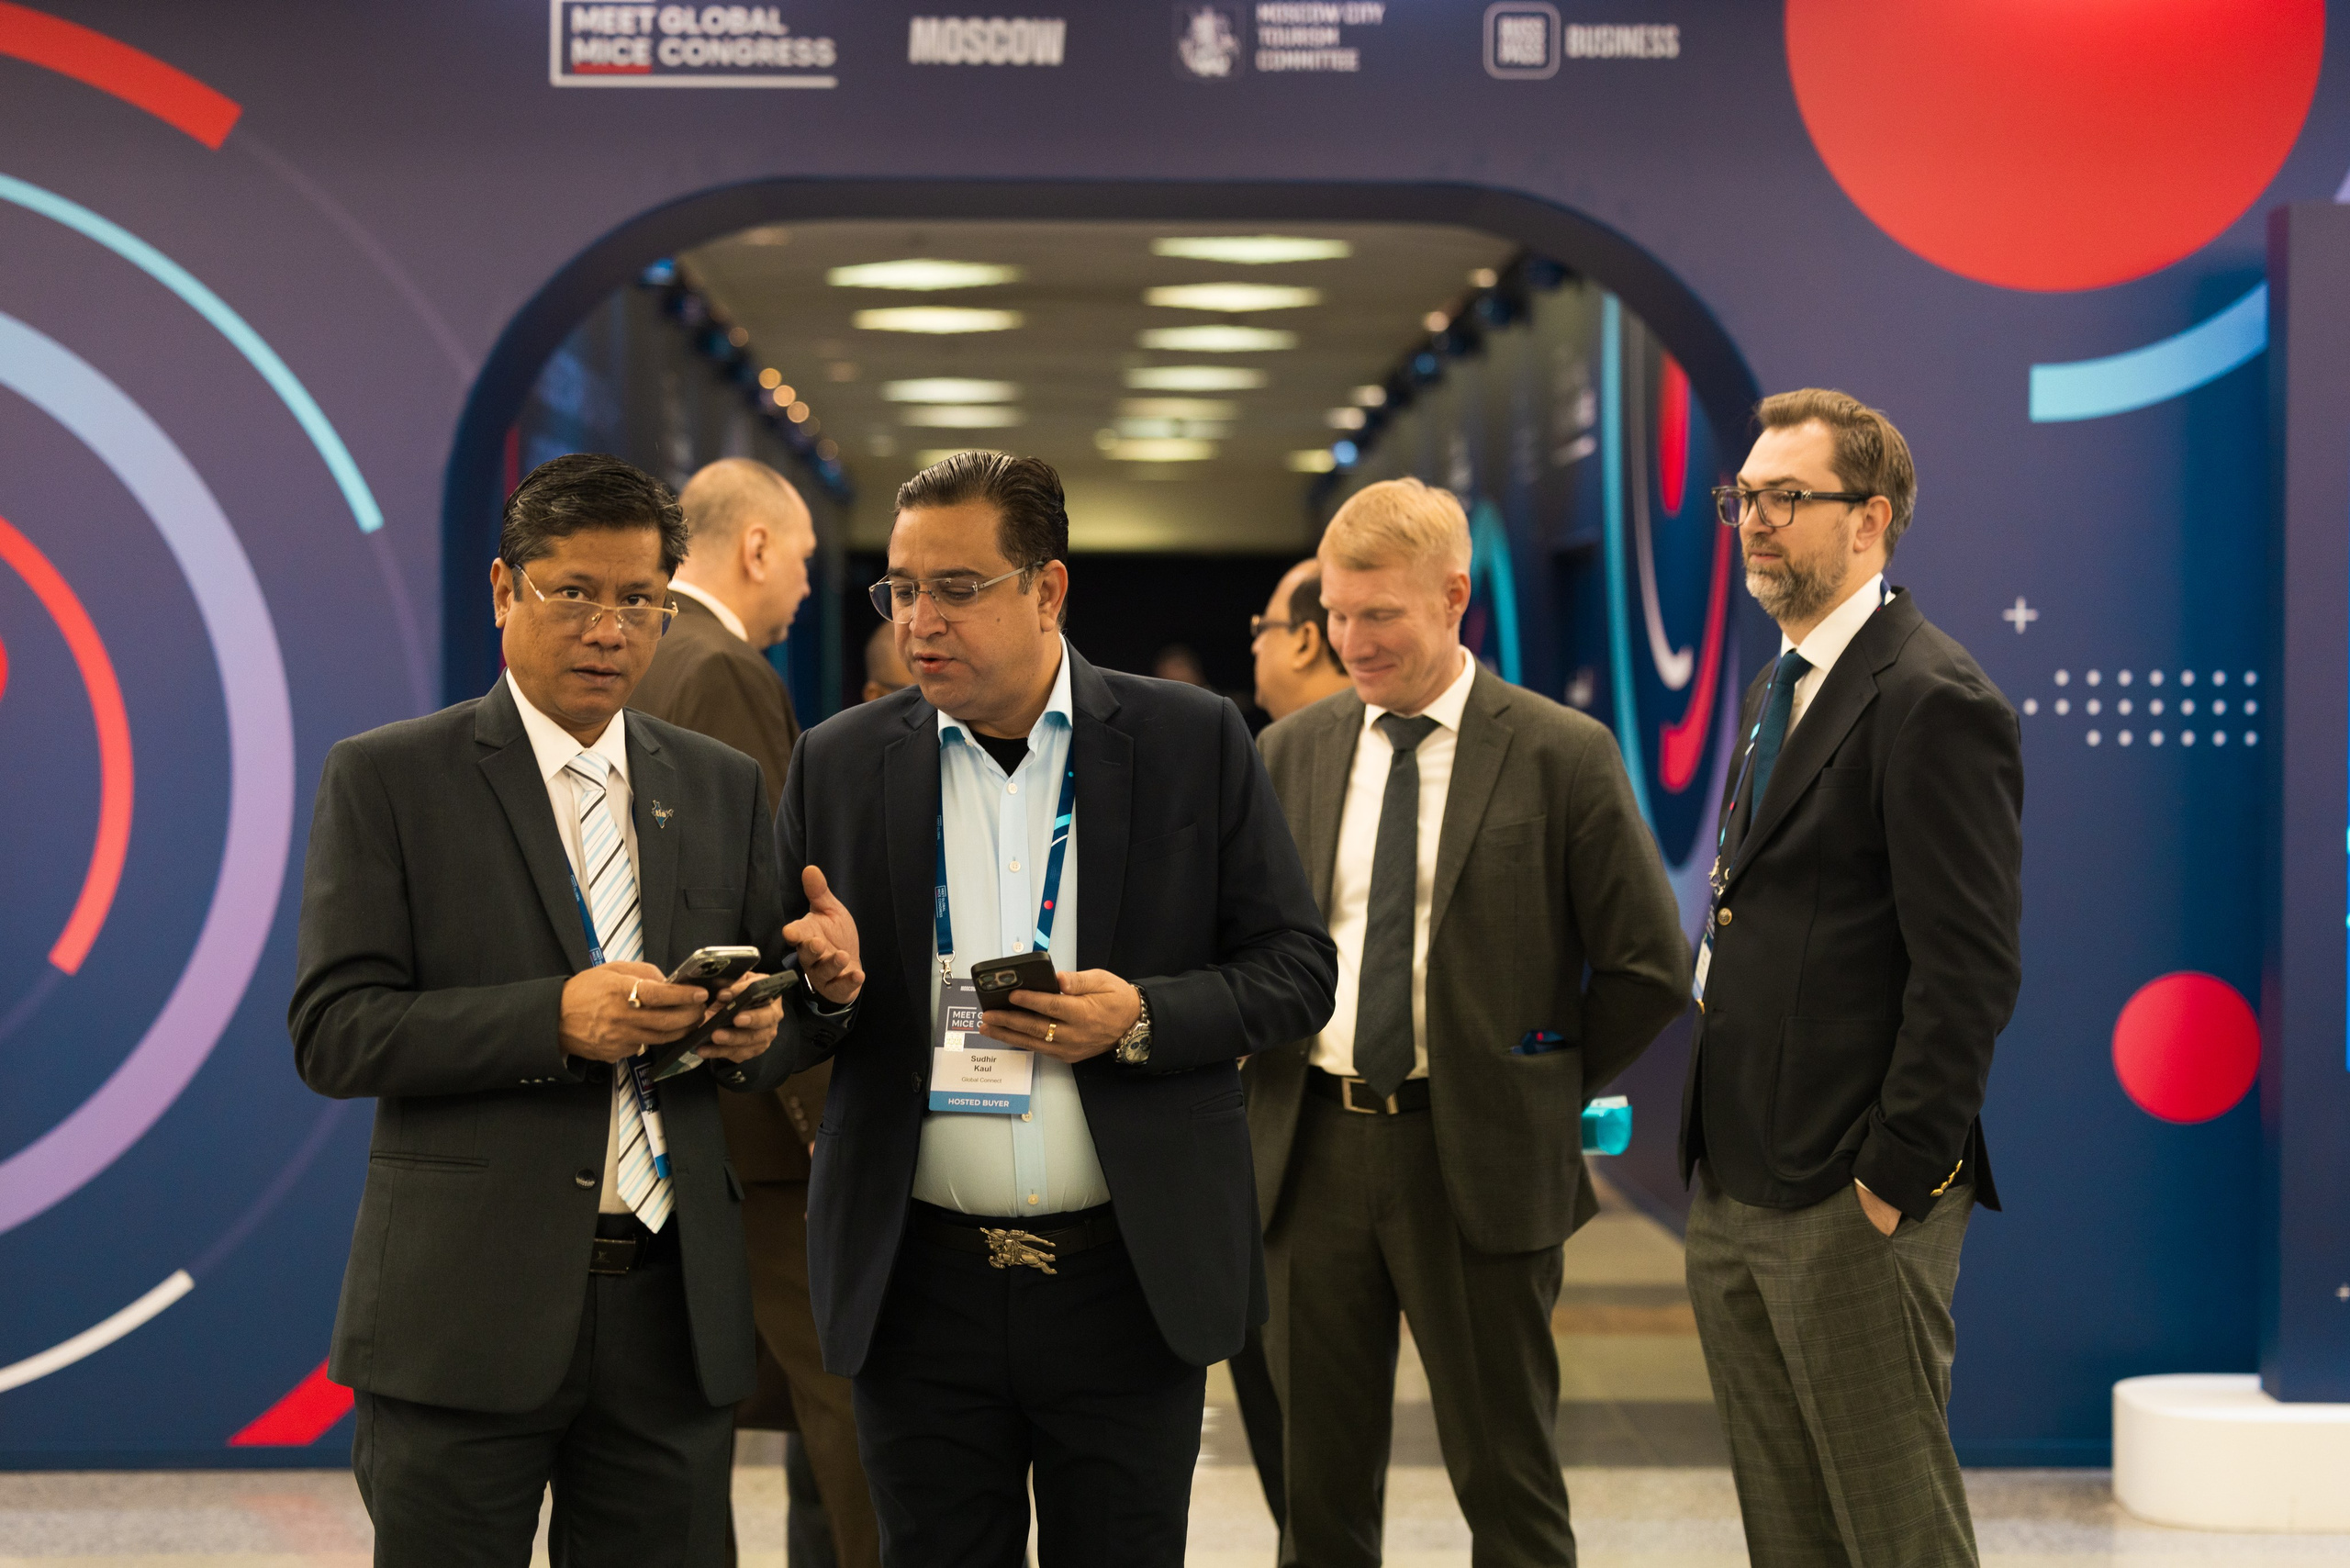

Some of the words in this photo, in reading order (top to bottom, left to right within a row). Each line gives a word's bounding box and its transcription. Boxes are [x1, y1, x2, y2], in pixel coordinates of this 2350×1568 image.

[571, 5, 657, 34] MEET
[658, 5, 789, 36] GLOBAL
[909, 16, 1067, 65] MOSCOW
[1258, 26, 1339, 47] TOURISM
[1564, 24, 1680, 58] BUSINESS
[571, 37, 653, 65] MICE
[658, 37, 837, 67] CONGRESS
[1256, 49, 1359, 72] COMMITTEE
[952, 1010, 977, 1019] MEET
[952, 1019, 975, 1027] MICE
[970, 1055, 997, 1063] Sudhir
[948, 1098, 981, 1106] HOSTED
[982, 1099, 1010, 1107] BUYER
